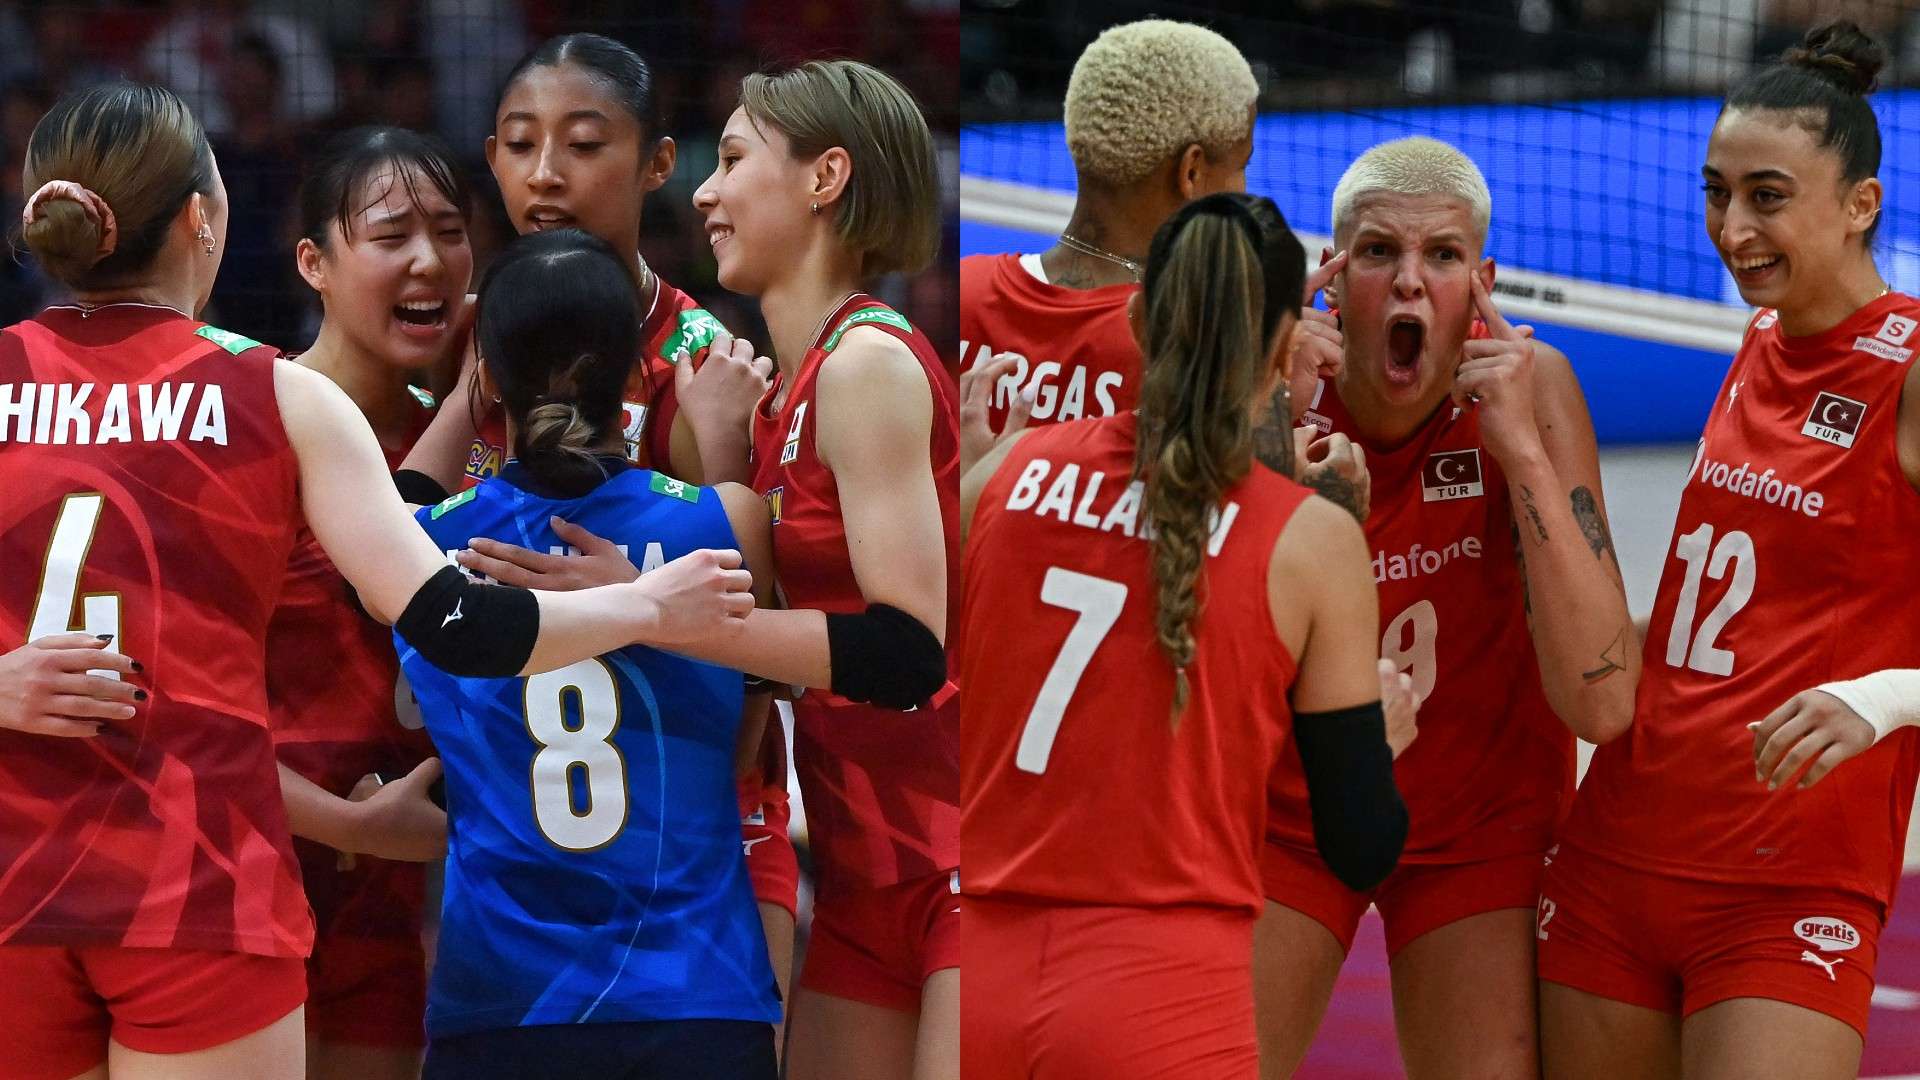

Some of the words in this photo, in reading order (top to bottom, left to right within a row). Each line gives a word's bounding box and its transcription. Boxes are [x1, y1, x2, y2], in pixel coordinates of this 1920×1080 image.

[1887, 321, 1906, 337] S
[0, 382, 228, 446] HIKAWA
[960, 340, 1123, 422] RGAS
[1815, 425, 1842, 443] TUR
[1005, 459, 1240, 557] BALAN
[1437, 486, 1470, 499] TUR
[1700, 458, 1825, 518] vodafone
[26, 492, 124, 680] 4
[1666, 522, 1757, 677] 12
[1016, 566, 1128, 775] 7
[1381, 599, 1438, 702] 9
[523, 655, 630, 853] 8
[1801, 922, 1855, 942] gratis
